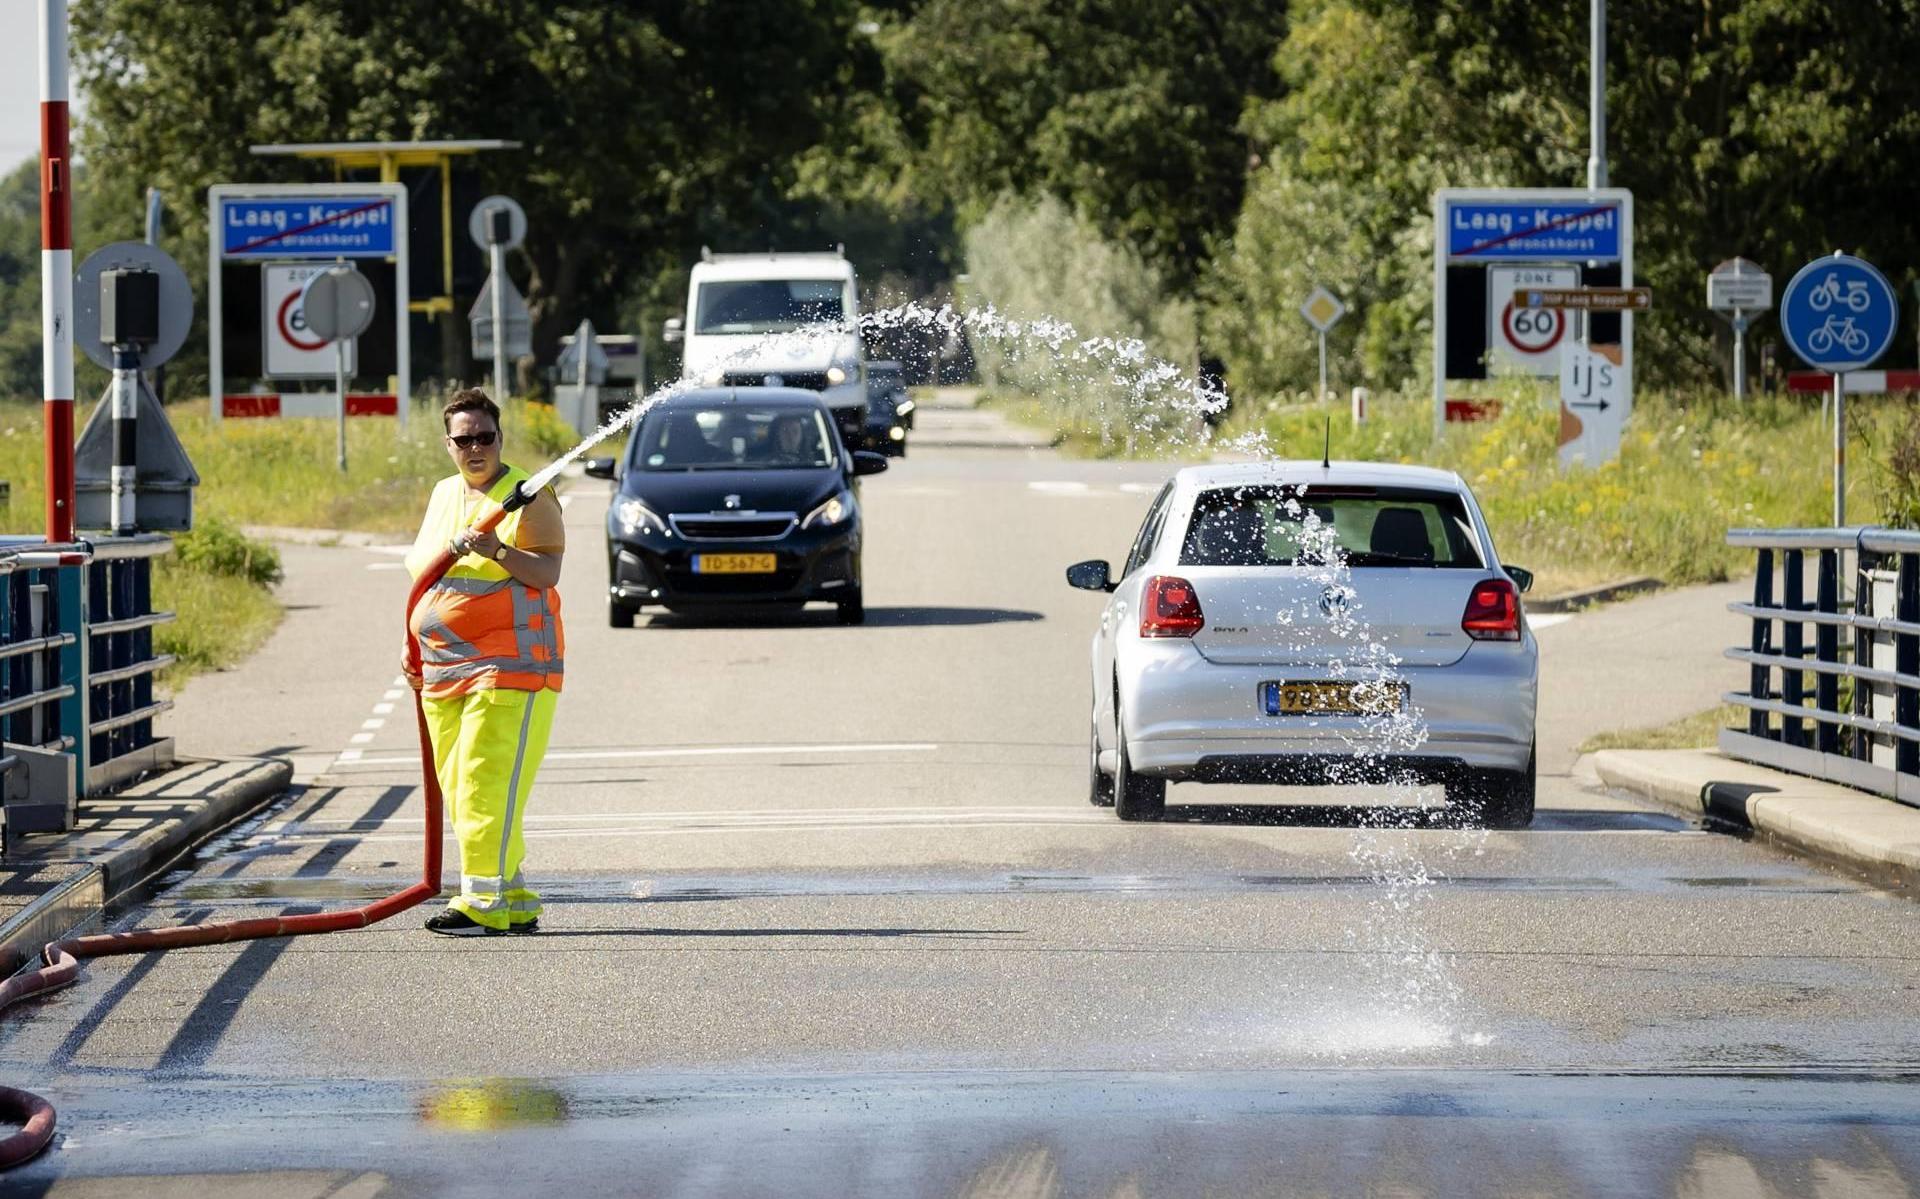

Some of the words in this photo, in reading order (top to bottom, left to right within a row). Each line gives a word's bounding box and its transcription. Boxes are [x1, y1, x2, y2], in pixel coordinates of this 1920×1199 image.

[229, 206, 287, 231] Laag
[308, 205, 388, 229] Keppel
[1455, 209, 1512, 234] Laag
[1534, 208, 1613, 232] Keppel
[1514, 272, 1553, 283] ZONE
[1515, 309, 1553, 334] 60
[1573, 355, 1613, 398] ijs
